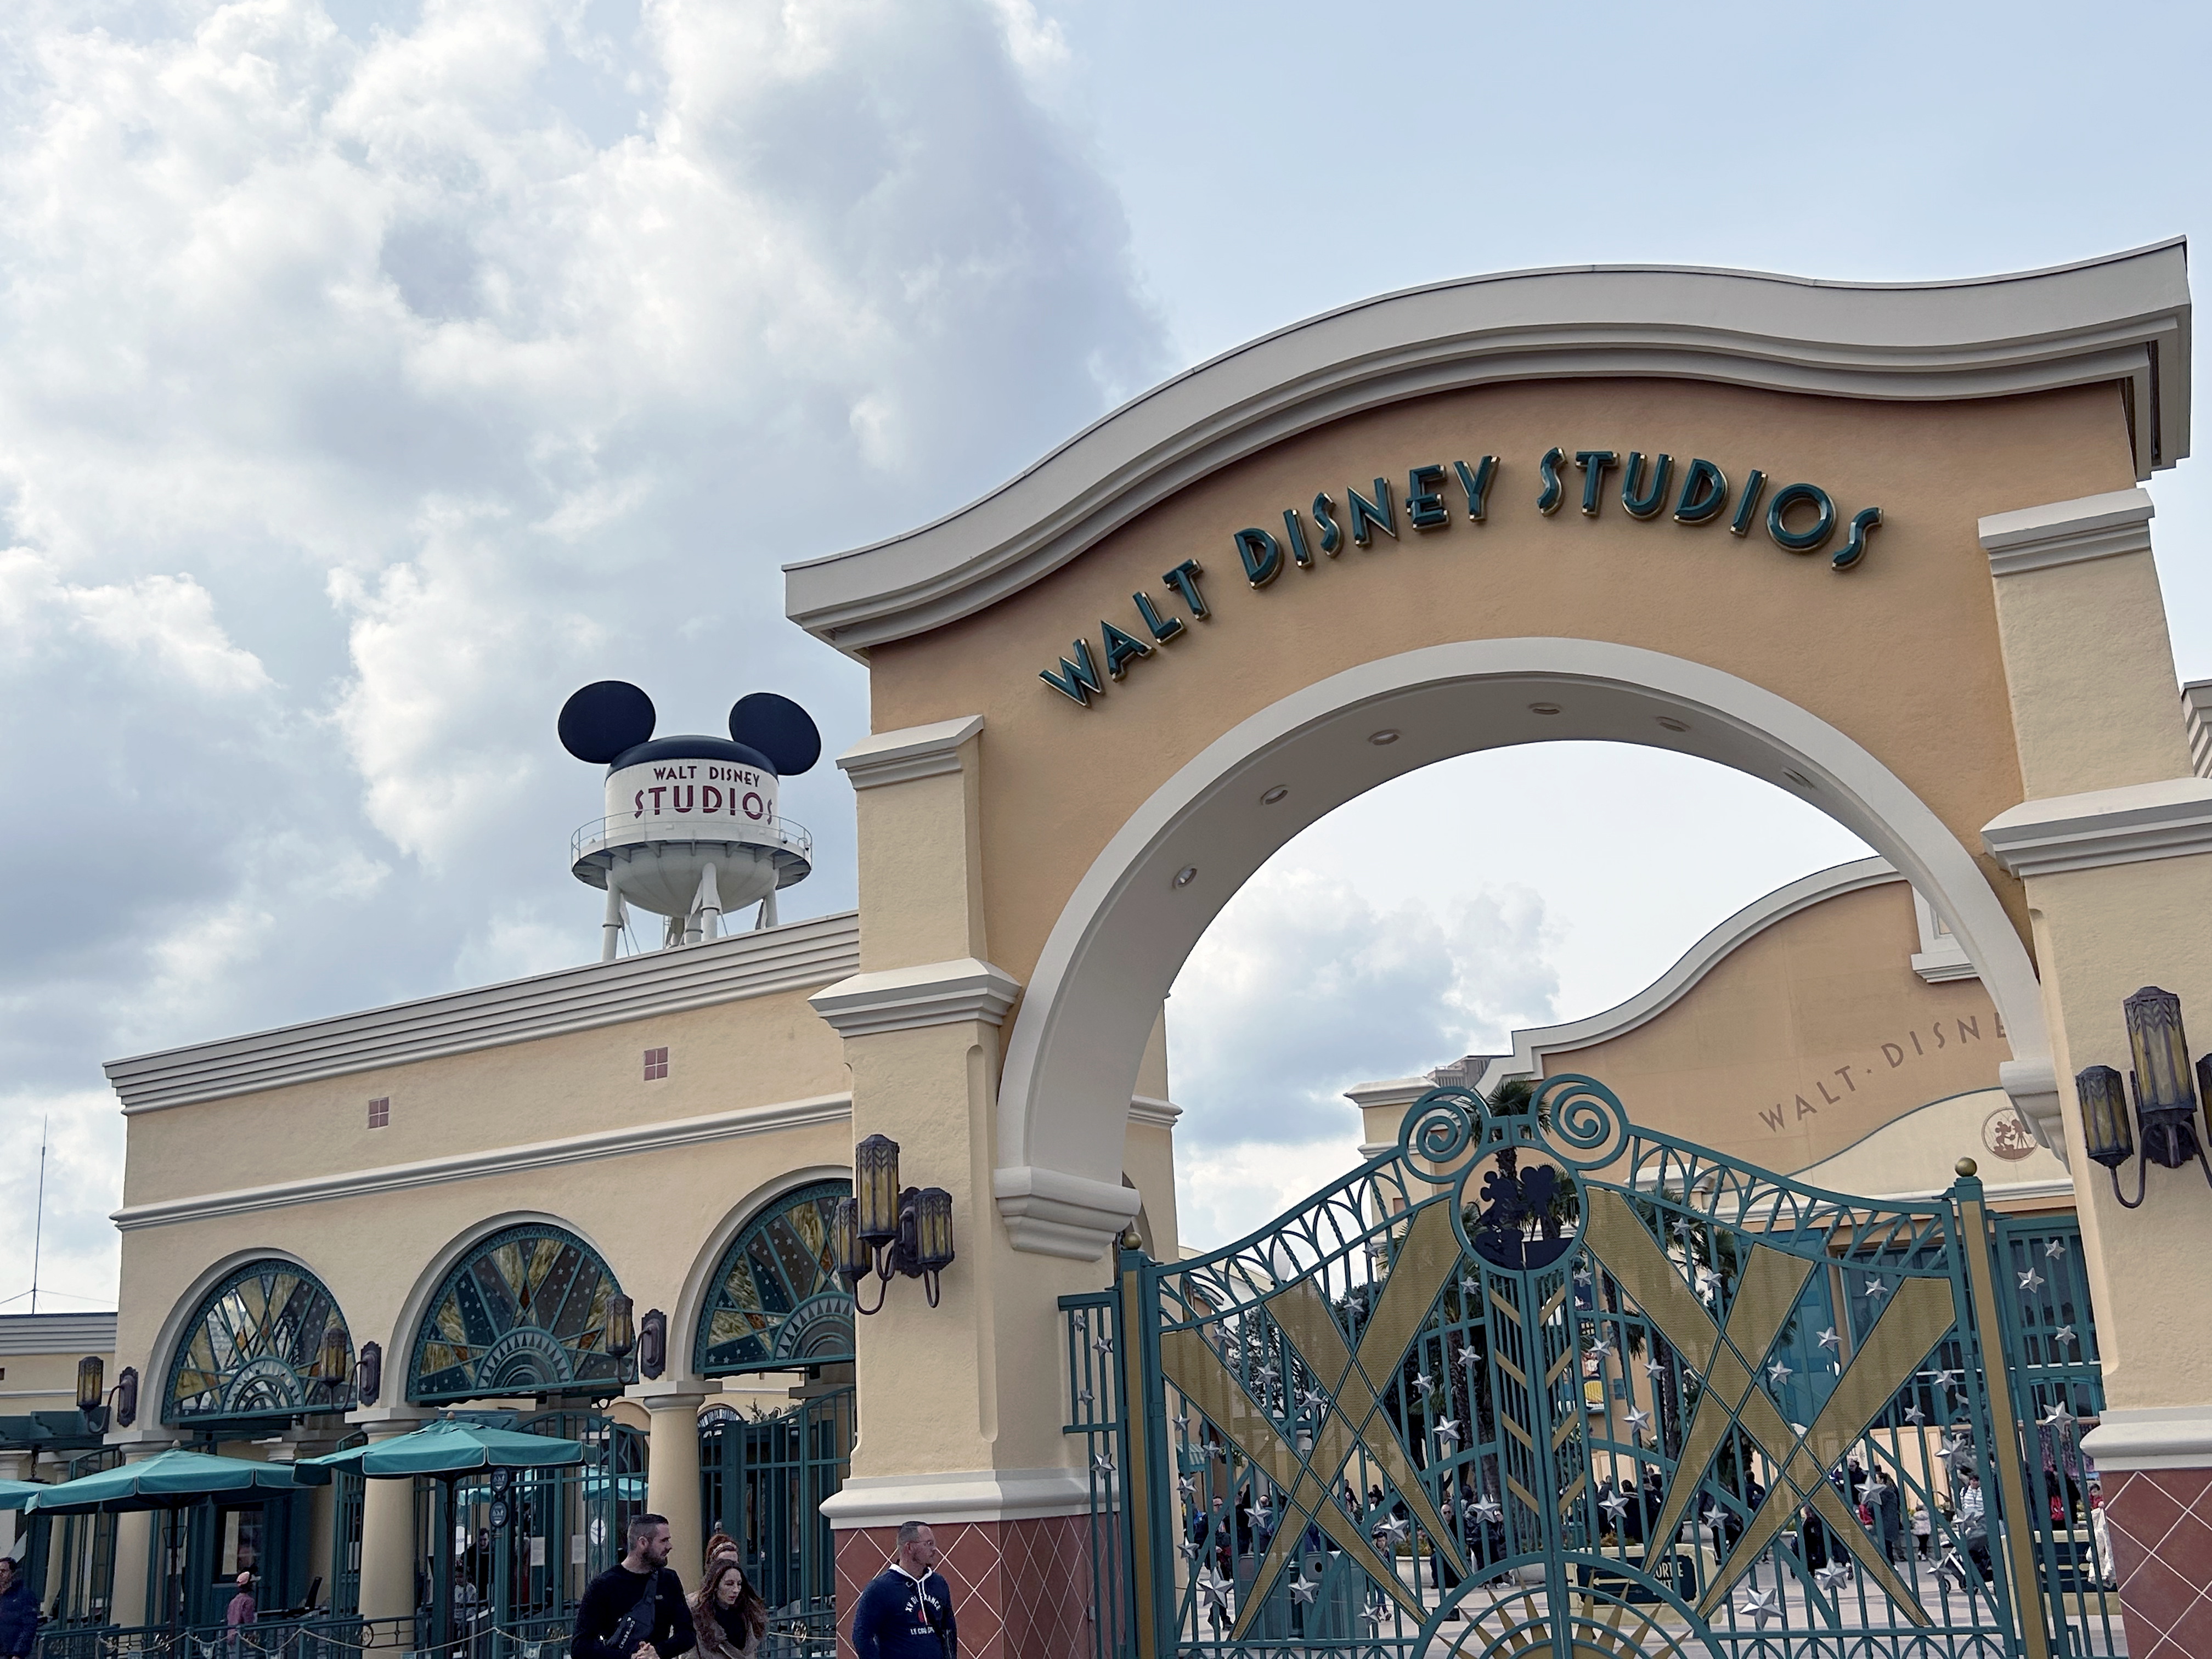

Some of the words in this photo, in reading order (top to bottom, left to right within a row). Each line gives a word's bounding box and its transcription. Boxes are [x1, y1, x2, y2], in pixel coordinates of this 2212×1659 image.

[1039, 558, 1210, 708] WALT
[1233, 455, 1500, 590] DISNEY
[1537, 447, 1883, 572] STUDIOS
[653, 766, 697, 781] WALT
[709, 766, 760, 787] DISNEY
[634, 785, 773, 825] STUDIOS
[1758, 1065, 1857, 1133] WALT
[1653, 1561, 1684, 1578] ORTE
[921, 1593, 941, 1611] RANCE
